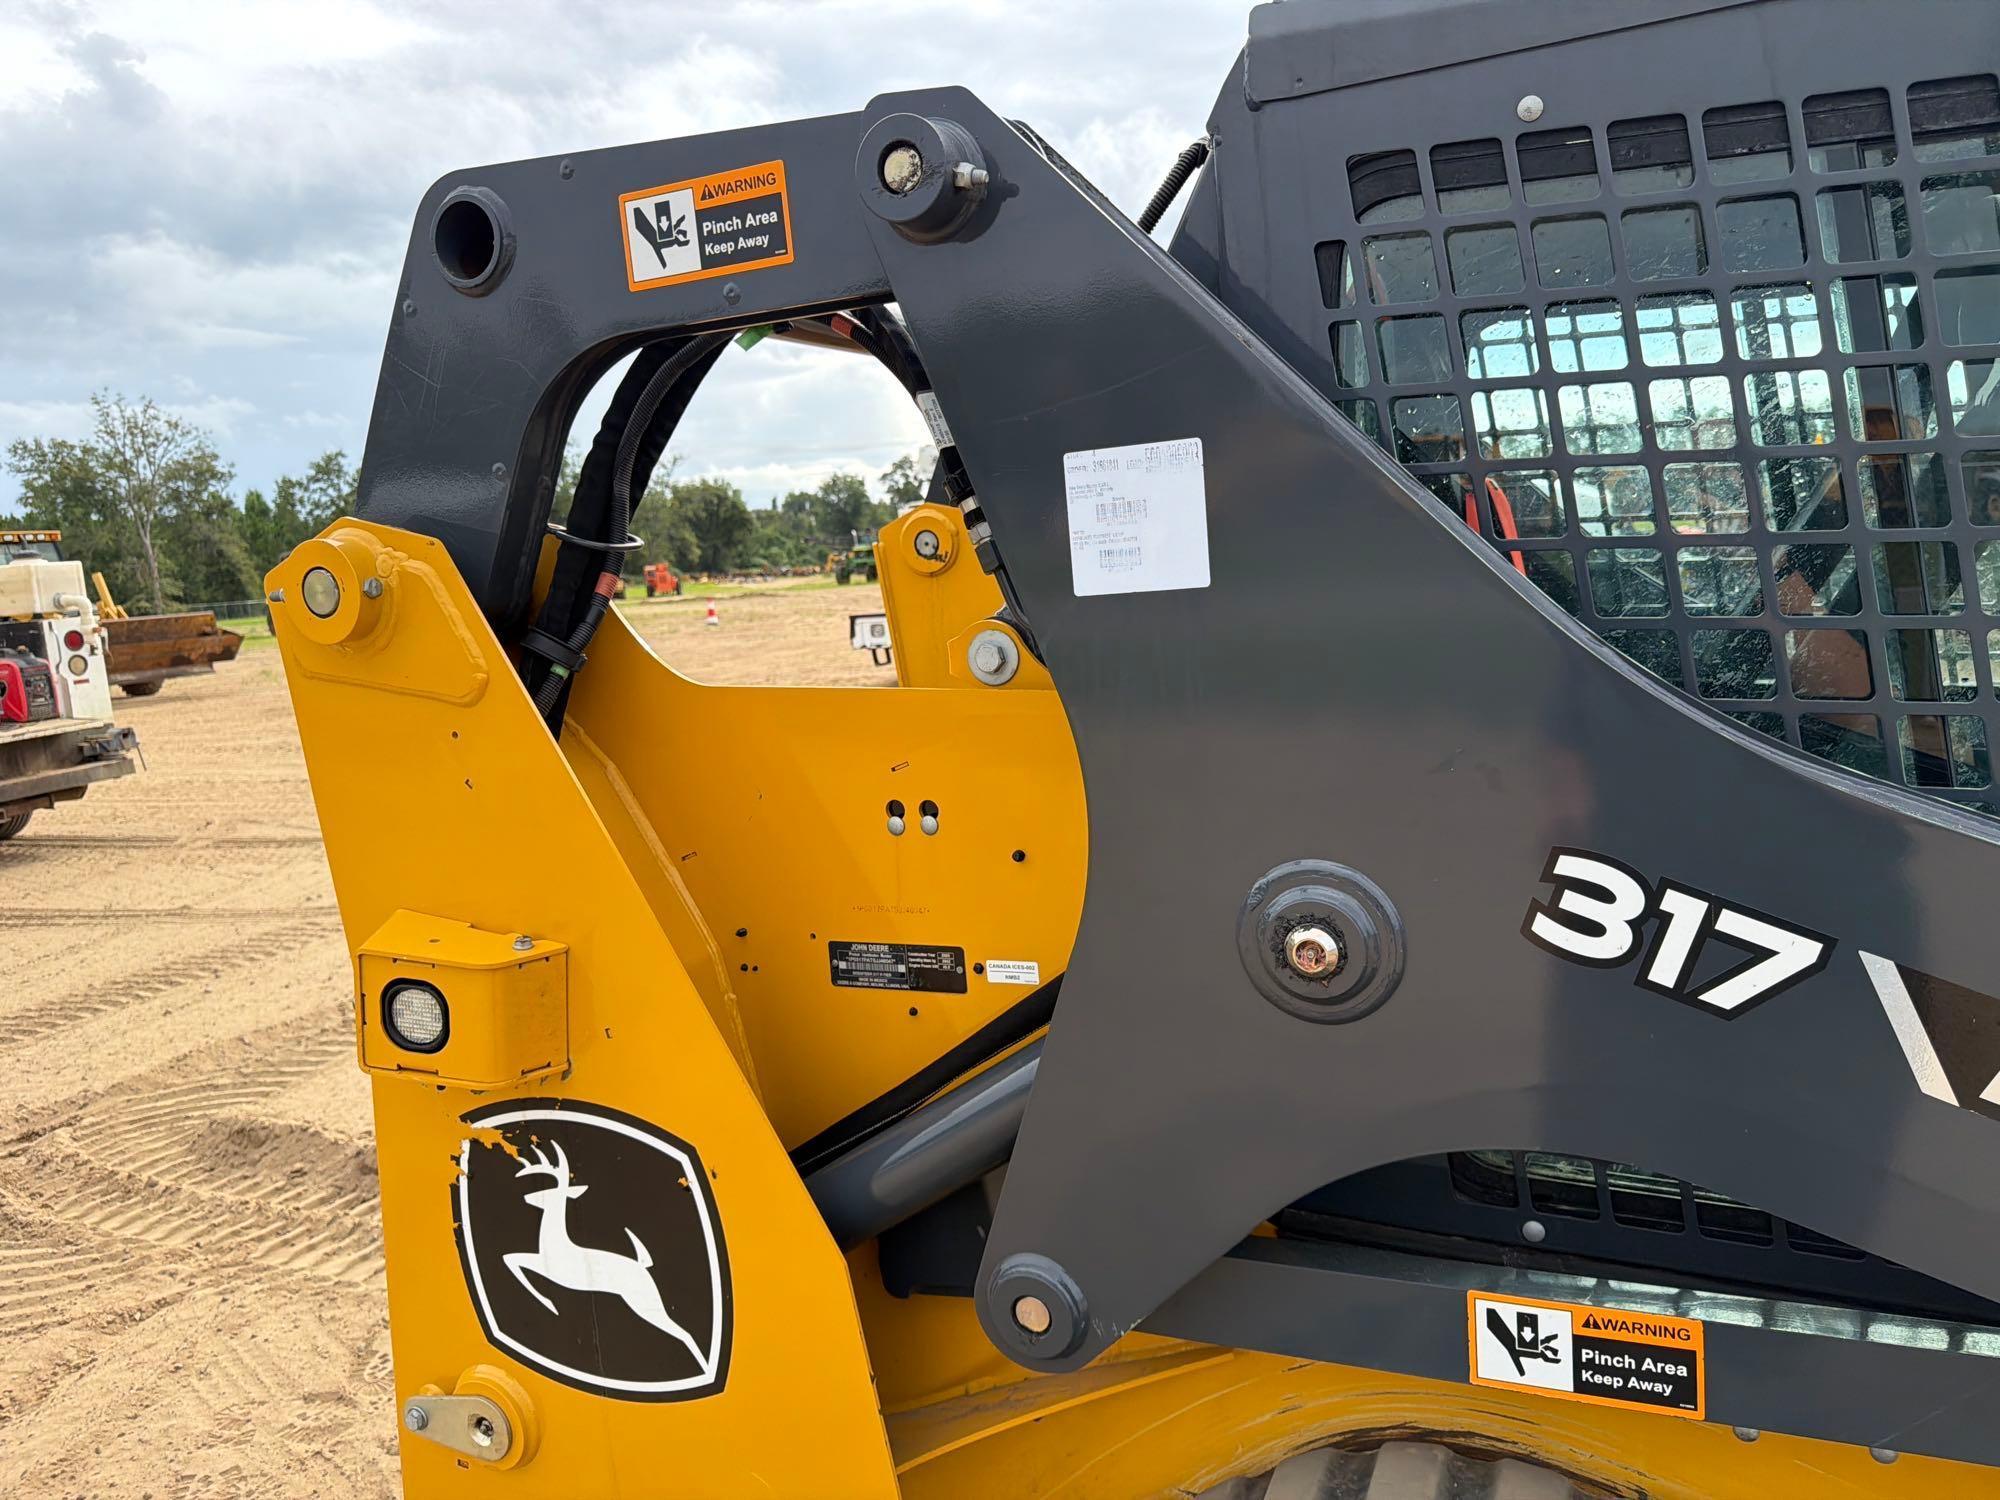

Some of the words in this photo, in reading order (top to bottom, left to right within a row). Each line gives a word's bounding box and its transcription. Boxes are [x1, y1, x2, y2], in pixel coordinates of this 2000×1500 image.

[713, 172, 776, 197] WARNING
[702, 216, 741, 236] Pinch
[745, 211, 778, 228] Area
[705, 241, 735, 256] Keep
[738, 234, 769, 250] Away
[1530, 854, 1824, 1011] 317
[850, 943, 868, 951] JOHN
[868, 944, 889, 952] DEERE
[1600, 1318, 1691, 1341] WARNING
[1581, 1348, 1636, 1370] Pinch
[1641, 1357, 1688, 1377] Area
[1581, 1369, 1623, 1389] Keep
[1627, 1377, 1673, 1397] Away
